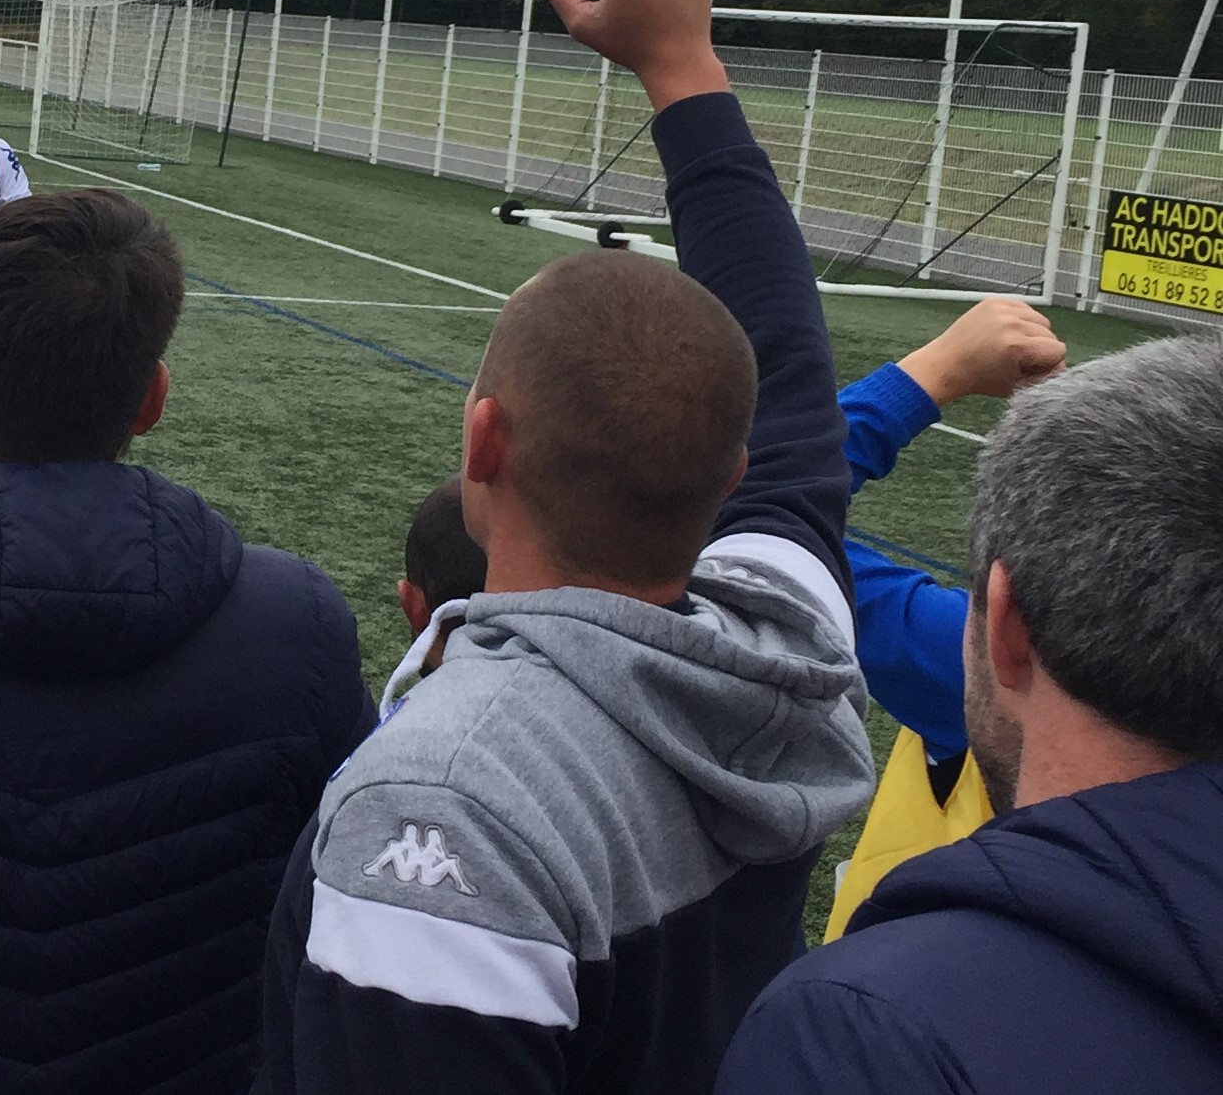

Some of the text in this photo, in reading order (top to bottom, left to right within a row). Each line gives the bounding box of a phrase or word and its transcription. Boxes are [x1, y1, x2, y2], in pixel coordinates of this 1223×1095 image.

[1115, 196, 1148, 223] AC
[1111, 222, 1223, 265] TRANSPOR
[1118, 272, 1136, 293] 06
[1141, 276, 1159, 297] 31
[1165, 281, 1184, 302] 89
[1189, 285, 1210, 307] 52
